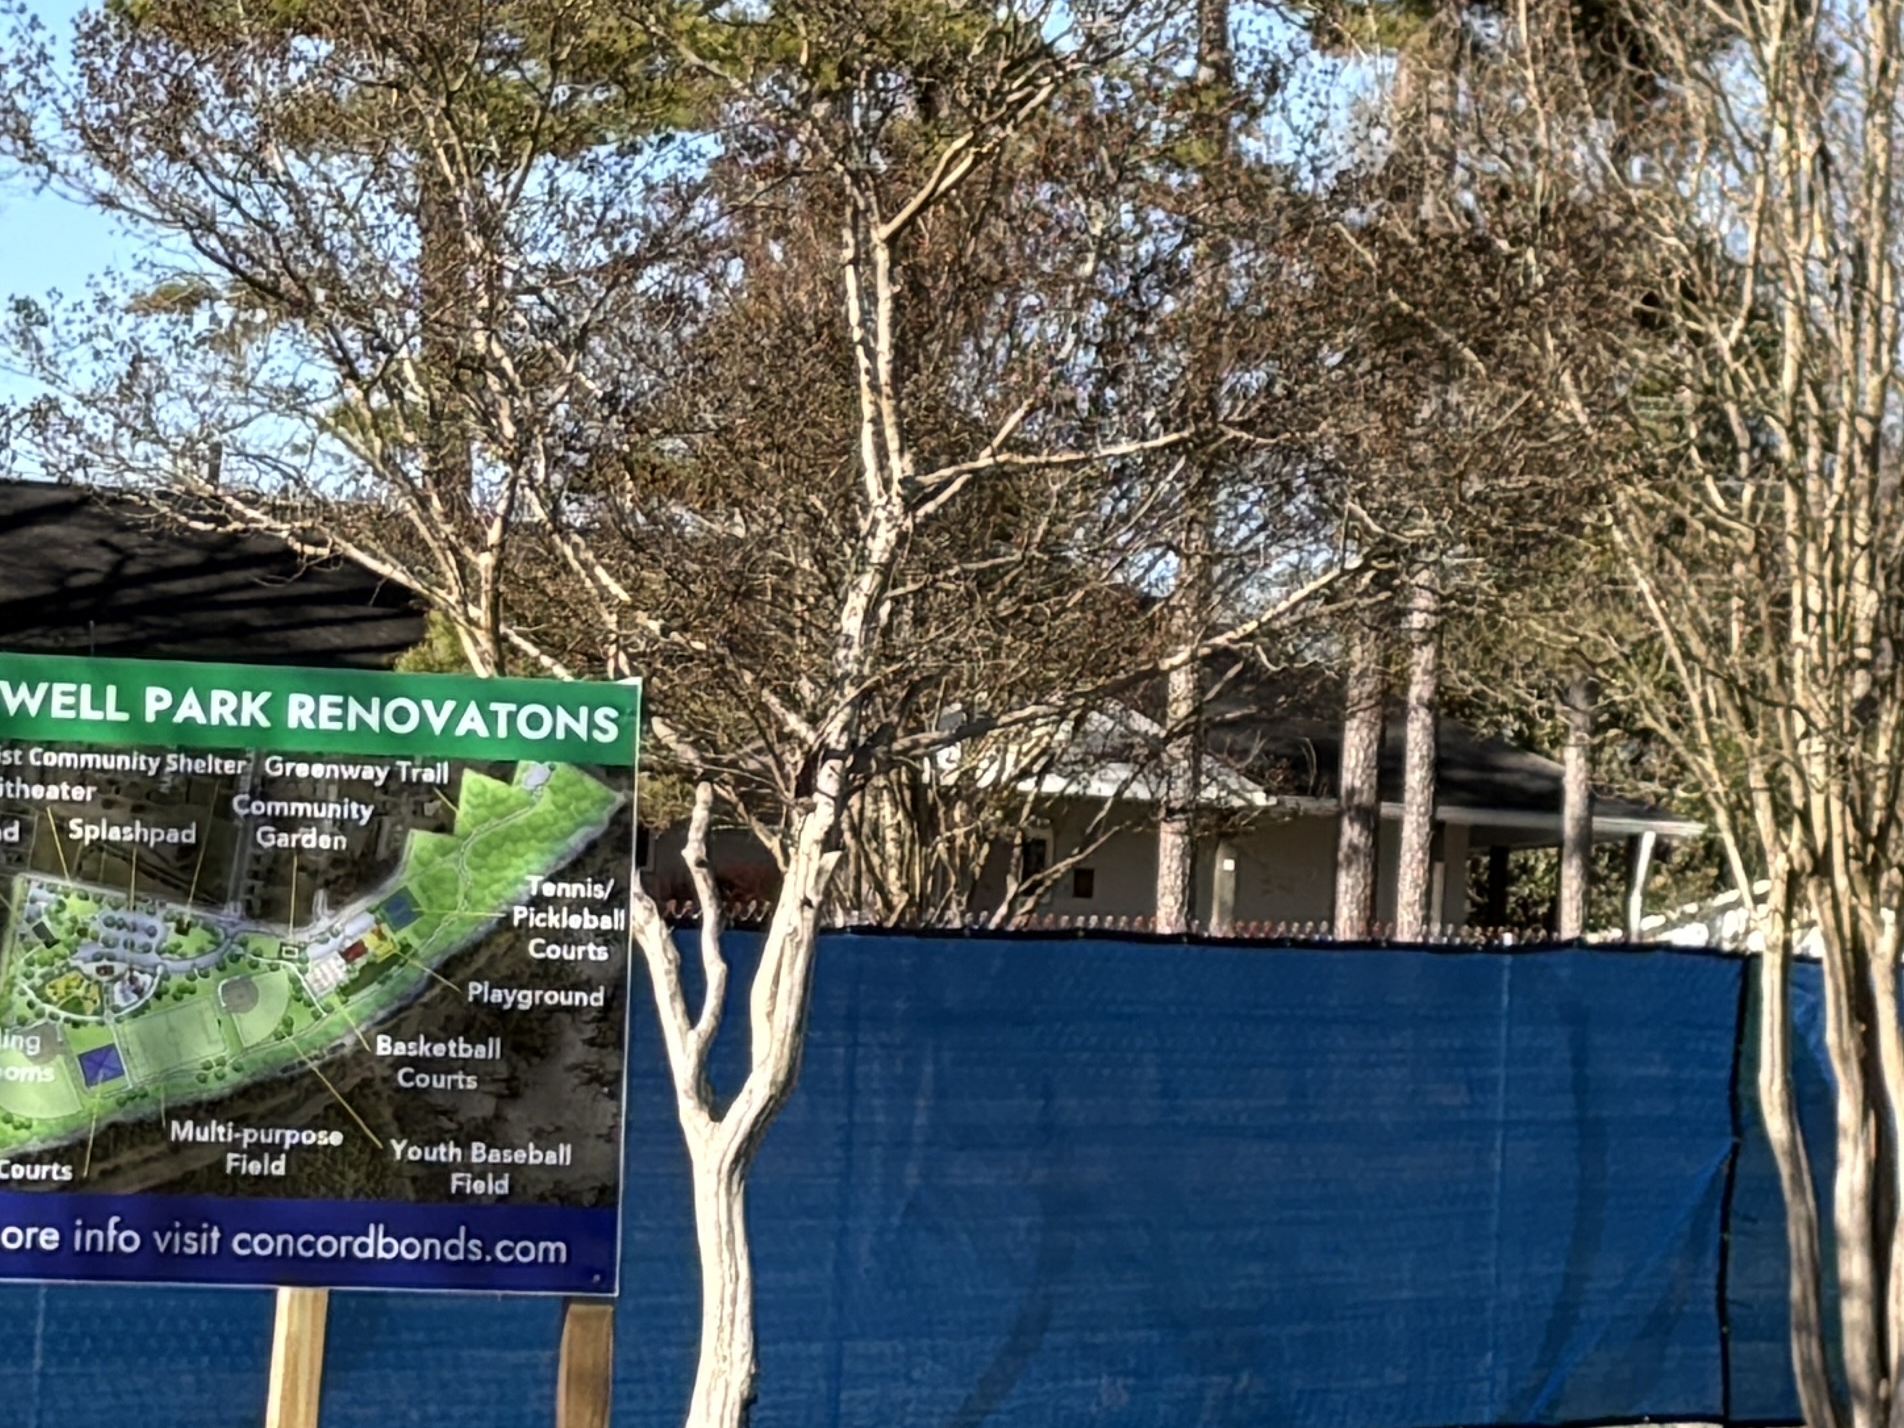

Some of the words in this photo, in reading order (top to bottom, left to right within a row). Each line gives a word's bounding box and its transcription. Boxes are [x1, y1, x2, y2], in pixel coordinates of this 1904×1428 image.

[145, 686, 272, 728] PARK
[287, 693, 619, 743] RENOVATONS
[28, 747, 161, 776] Community
[165, 753, 247, 775] Shelter
[264, 756, 390, 786] Greenway
[397, 760, 449, 785] Trail
[232, 794, 374, 825] Community
[68, 817, 197, 848] Splashpad
[256, 825, 347, 851] Garden
[529, 875, 615, 901] Tennis/
[512, 906, 625, 932] Pickleball
[528, 938, 610, 962] Courts
[467, 981, 605, 1010] Playground
[376, 1034, 502, 1061] Basketball
[397, 1067, 478, 1091] Courts
[170, 1119, 345, 1151] Multi-purpose
[225, 1152, 286, 1176] Field
[390, 1138, 463, 1164] Youth
[470, 1141, 572, 1167] Baseball
[450, 1171, 510, 1196] Field
[73, 1216, 141, 1254] info
[152, 1220, 221, 1257] visit
[231, 1224, 568, 1264] concordbonds.com
